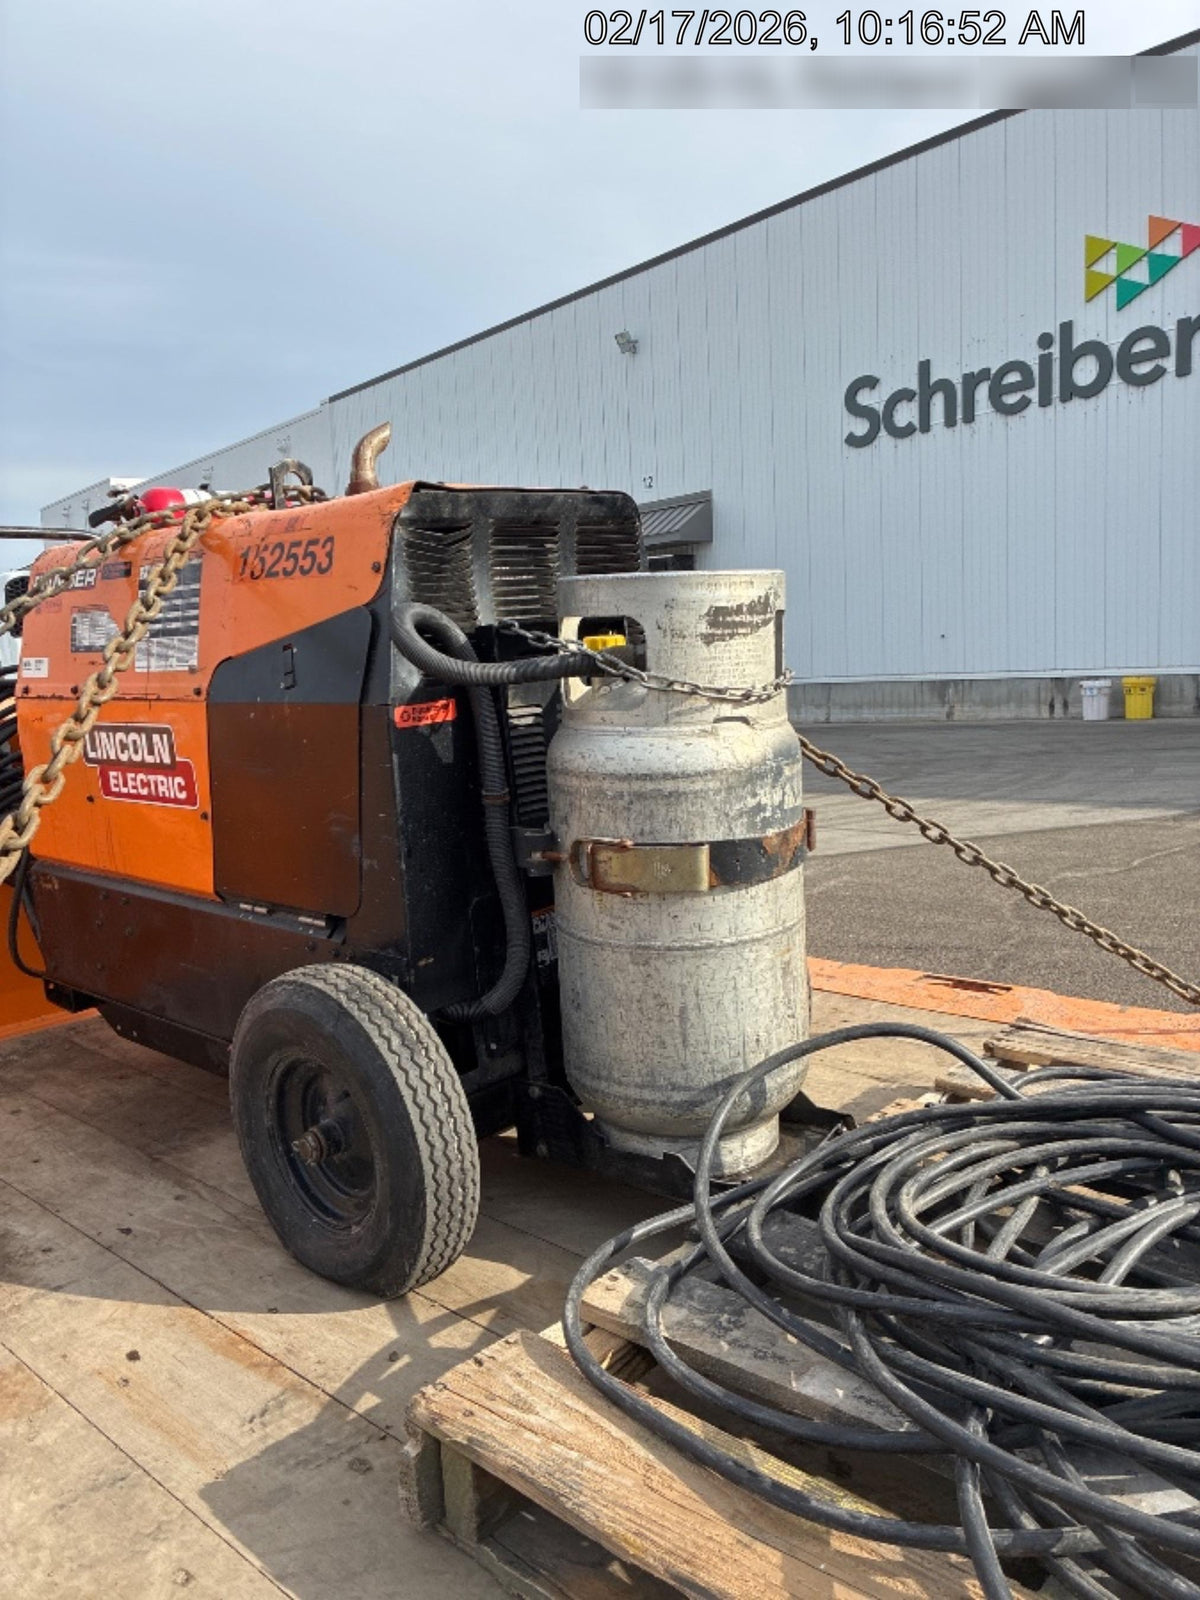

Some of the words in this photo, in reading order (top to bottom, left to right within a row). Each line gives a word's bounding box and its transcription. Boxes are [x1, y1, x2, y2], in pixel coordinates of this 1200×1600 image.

[844, 314, 1200, 449] Schreiber
[84, 730, 171, 765] LINCOLN
[108, 770, 187, 799] ELECTRIC
